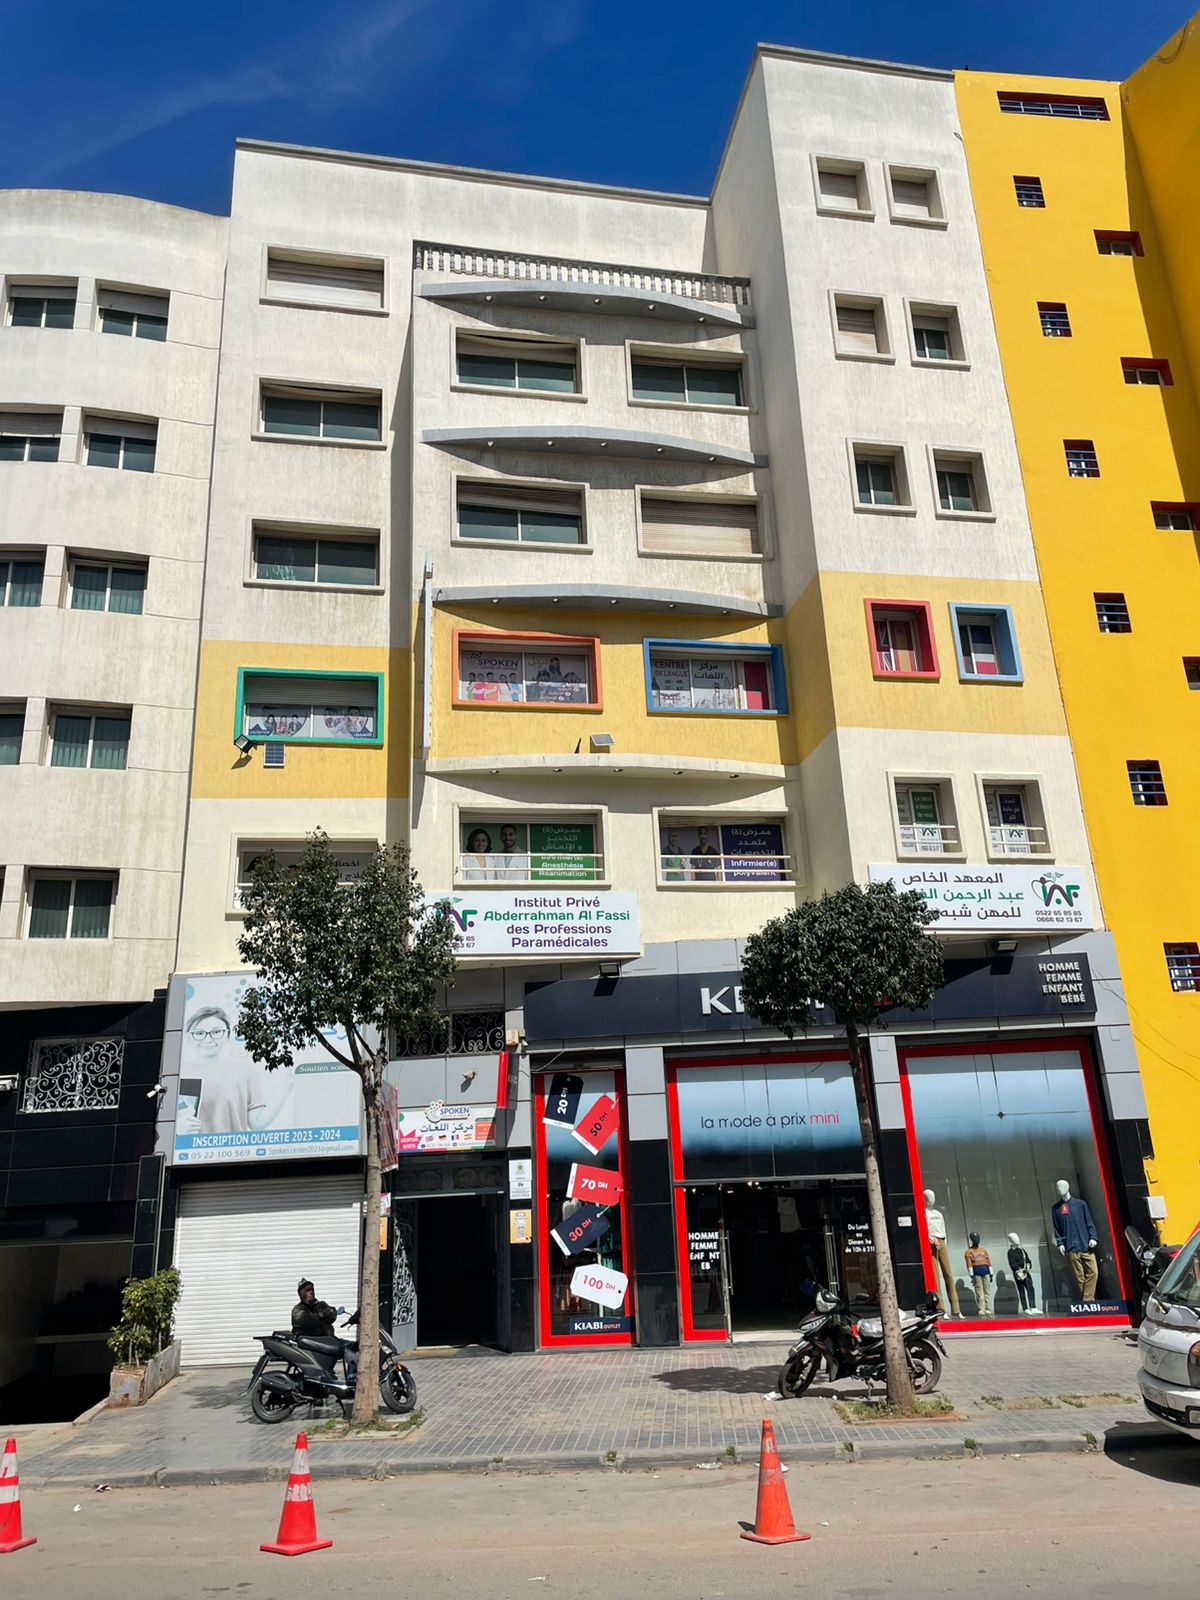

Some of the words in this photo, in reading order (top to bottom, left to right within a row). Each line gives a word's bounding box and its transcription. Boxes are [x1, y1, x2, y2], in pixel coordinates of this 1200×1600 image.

[477, 658, 518, 668] SPOKEN
[655, 660, 685, 670] CENTRE
[731, 859, 777, 867] Infirmier(e)
[902, 871, 948, 886] الخاص
[954, 872, 1003, 884] المعهد
[943, 888, 991, 903] الرحمن
[997, 891, 1024, 901] عبد
[514, 896, 561, 908] Institut
[566, 896, 600, 908] Privé
[484, 910, 574, 921] Abderrahman
[578, 910, 592, 921] Al
[596, 910, 630, 921] Fassi
[977, 906, 1021, 920] للمهن
[506, 923, 530, 935] des
[534, 923, 612, 935] Professions
[511, 936, 608, 948] Paramédicales
[1038, 961, 1080, 972] HOMME
[1046, 972, 1082, 982] FEMME
[1042, 983, 1083, 993] ENFANT
[1060, 991, 1086, 1004] BÉBÉ
[299, 1064, 329, 1072] Soutien
[560, 1087, 568, 1098] DH
[440, 1107, 470, 1115] SPOKEN
[557, 1099, 568, 1115] 20
[589, 1122, 602, 1137] 50
[599, 1112, 608, 1122] DH
[701, 1116, 714, 1129] la
[718, 1114, 762, 1128] mode
[766, 1113, 776, 1127] à
[781, 1112, 807, 1128] prix
[809, 1111, 840, 1124] mini
[420, 1123, 449, 1133] اللغات
[452, 1123, 474, 1134] مركز
[192, 1134, 249, 1148] INSCRIPTION
[250, 1131, 289, 1144] OUVERTE
[291, 1130, 313, 1142] 2023
[319, 1129, 341, 1141] 2024
[191, 1151, 202, 1160] 05
[203, 1151, 214, 1159] 22
[217, 1150, 232, 1158] 100
[234, 1149, 250, 1158] 569
[580, 1178, 596, 1190] 70
[597, 1181, 608, 1189] DH
[569, 1226, 583, 1242] 30
[581, 1218, 592, 1228] DH
[688, 1231, 719, 1240] HOMME
[690, 1241, 718, 1250] FEMME
[583, 1274, 603, 1290] 100
[605, 1282, 616, 1291] DH
[1070, 1303, 1101, 1313] KIABI
[574, 1321, 603, 1331] KIABI
